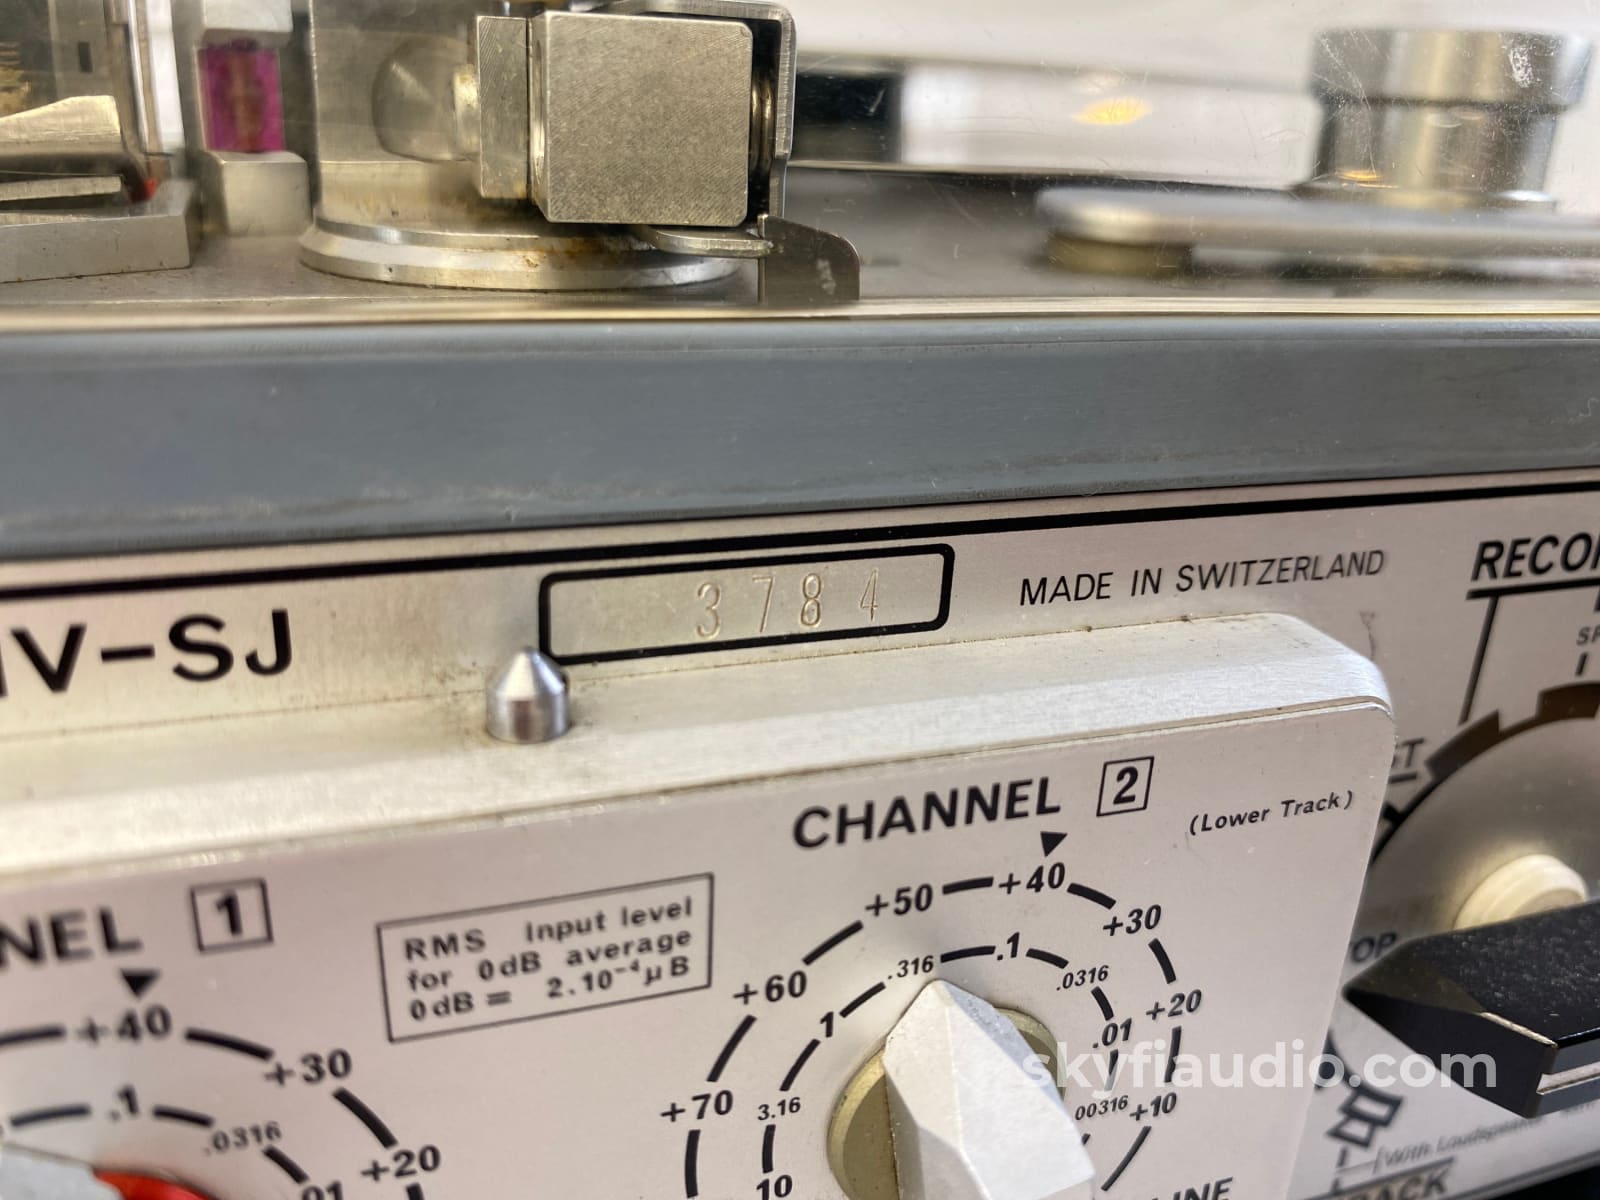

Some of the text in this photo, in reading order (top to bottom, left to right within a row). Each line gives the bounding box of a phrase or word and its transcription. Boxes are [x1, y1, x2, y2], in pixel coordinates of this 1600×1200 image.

[1019, 549, 1386, 606] MADE IN SWITZERLAND
[793, 766, 1139, 849] CHANNEL 2
[1190, 790, 1353, 835] (Lower Track)
[998, 862, 1066, 894] +40
[216, 890, 243, 935] 1
[864, 884, 933, 917] +50
[403, 896, 692, 962] RMS Input level
[1102, 904, 1162, 937] +30
[408, 971, 453, 991] for
[566, 930, 693, 966] average
[997, 931, 1021, 961] .1
[888, 955, 934, 979] .316
[1056, 965, 1109, 990] .0316
[733, 970, 807, 1005] +60
[1145, 989, 1202, 1020] +20
[76, 1004, 172, 1041] +40
[820, 1011, 834, 1038] 1
[1092, 1018, 1132, 1049] .01
[265, 1048, 352, 1085] +30
[107, 1085, 139, 1121] .1
[660, 1089, 734, 1122] +70
[757, 1097, 801, 1121] 3.16
[1129, 1092, 1178, 1121] +10
[361, 1144, 441, 1182] +20
[756, 1174, 793, 1200] 10
